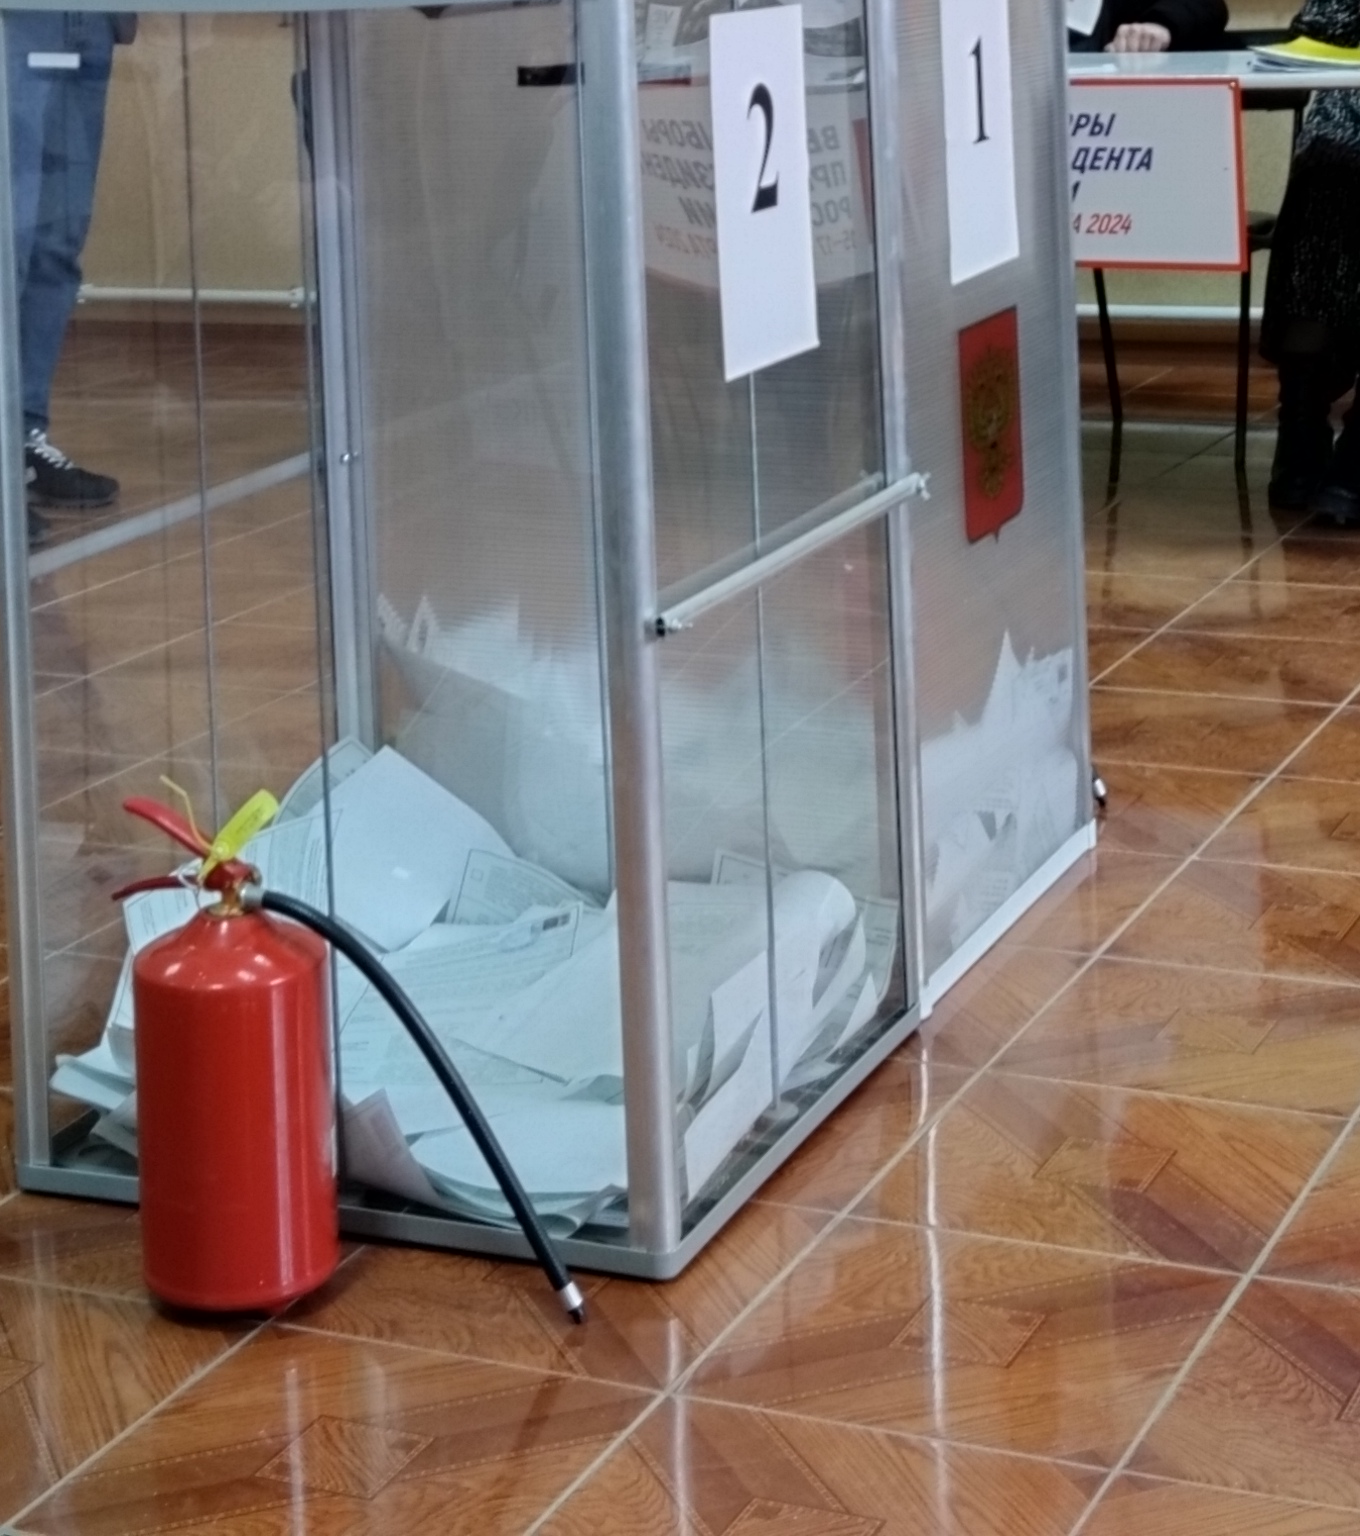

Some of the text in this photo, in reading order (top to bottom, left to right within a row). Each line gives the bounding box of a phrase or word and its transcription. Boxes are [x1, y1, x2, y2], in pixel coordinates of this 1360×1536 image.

[967, 35, 990, 145] 1
[746, 81, 780, 215] 2
[1071, 146, 1154, 174] ДЕНТА
[1085, 213, 1133, 236] 2024
